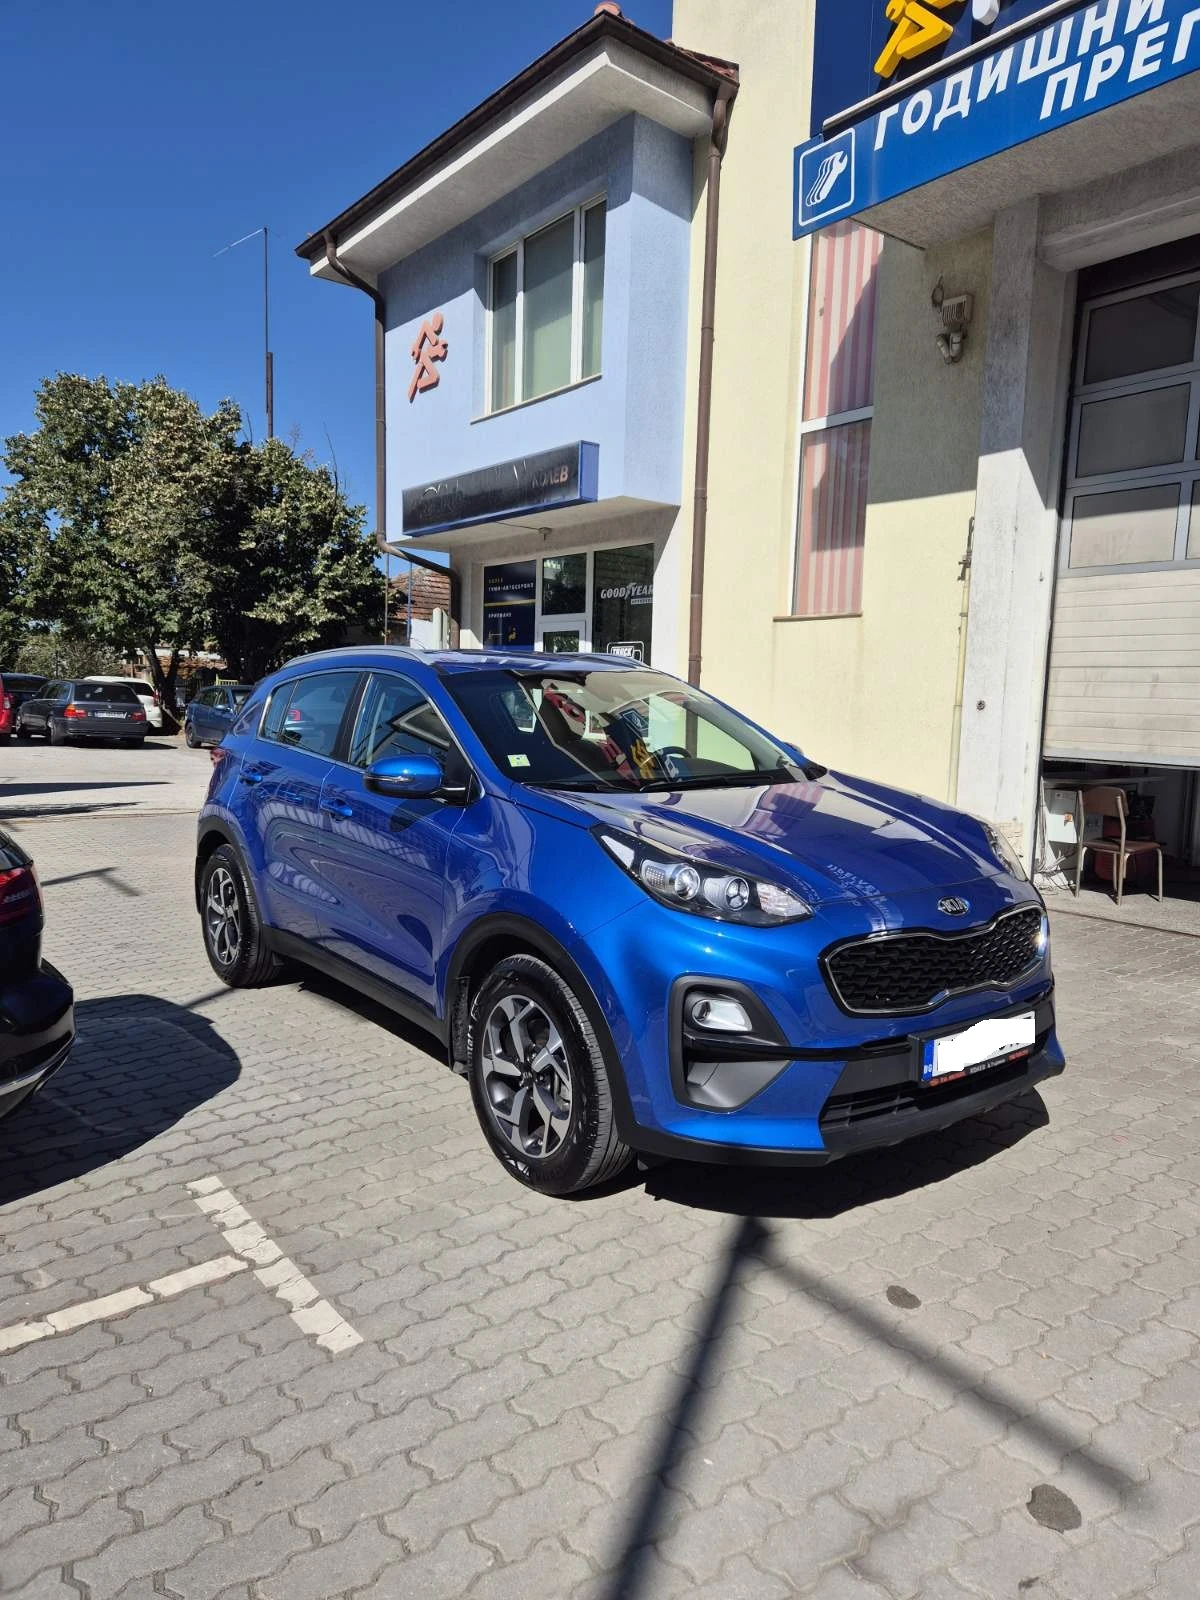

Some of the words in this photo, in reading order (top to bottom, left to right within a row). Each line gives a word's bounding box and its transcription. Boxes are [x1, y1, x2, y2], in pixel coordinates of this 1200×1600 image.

[874, 0, 1165, 151] ГОДИШНИ
[612, 647, 633, 657] TRUCK
[940, 897, 968, 913] KIA
[923, 1065, 933, 1074] BG
